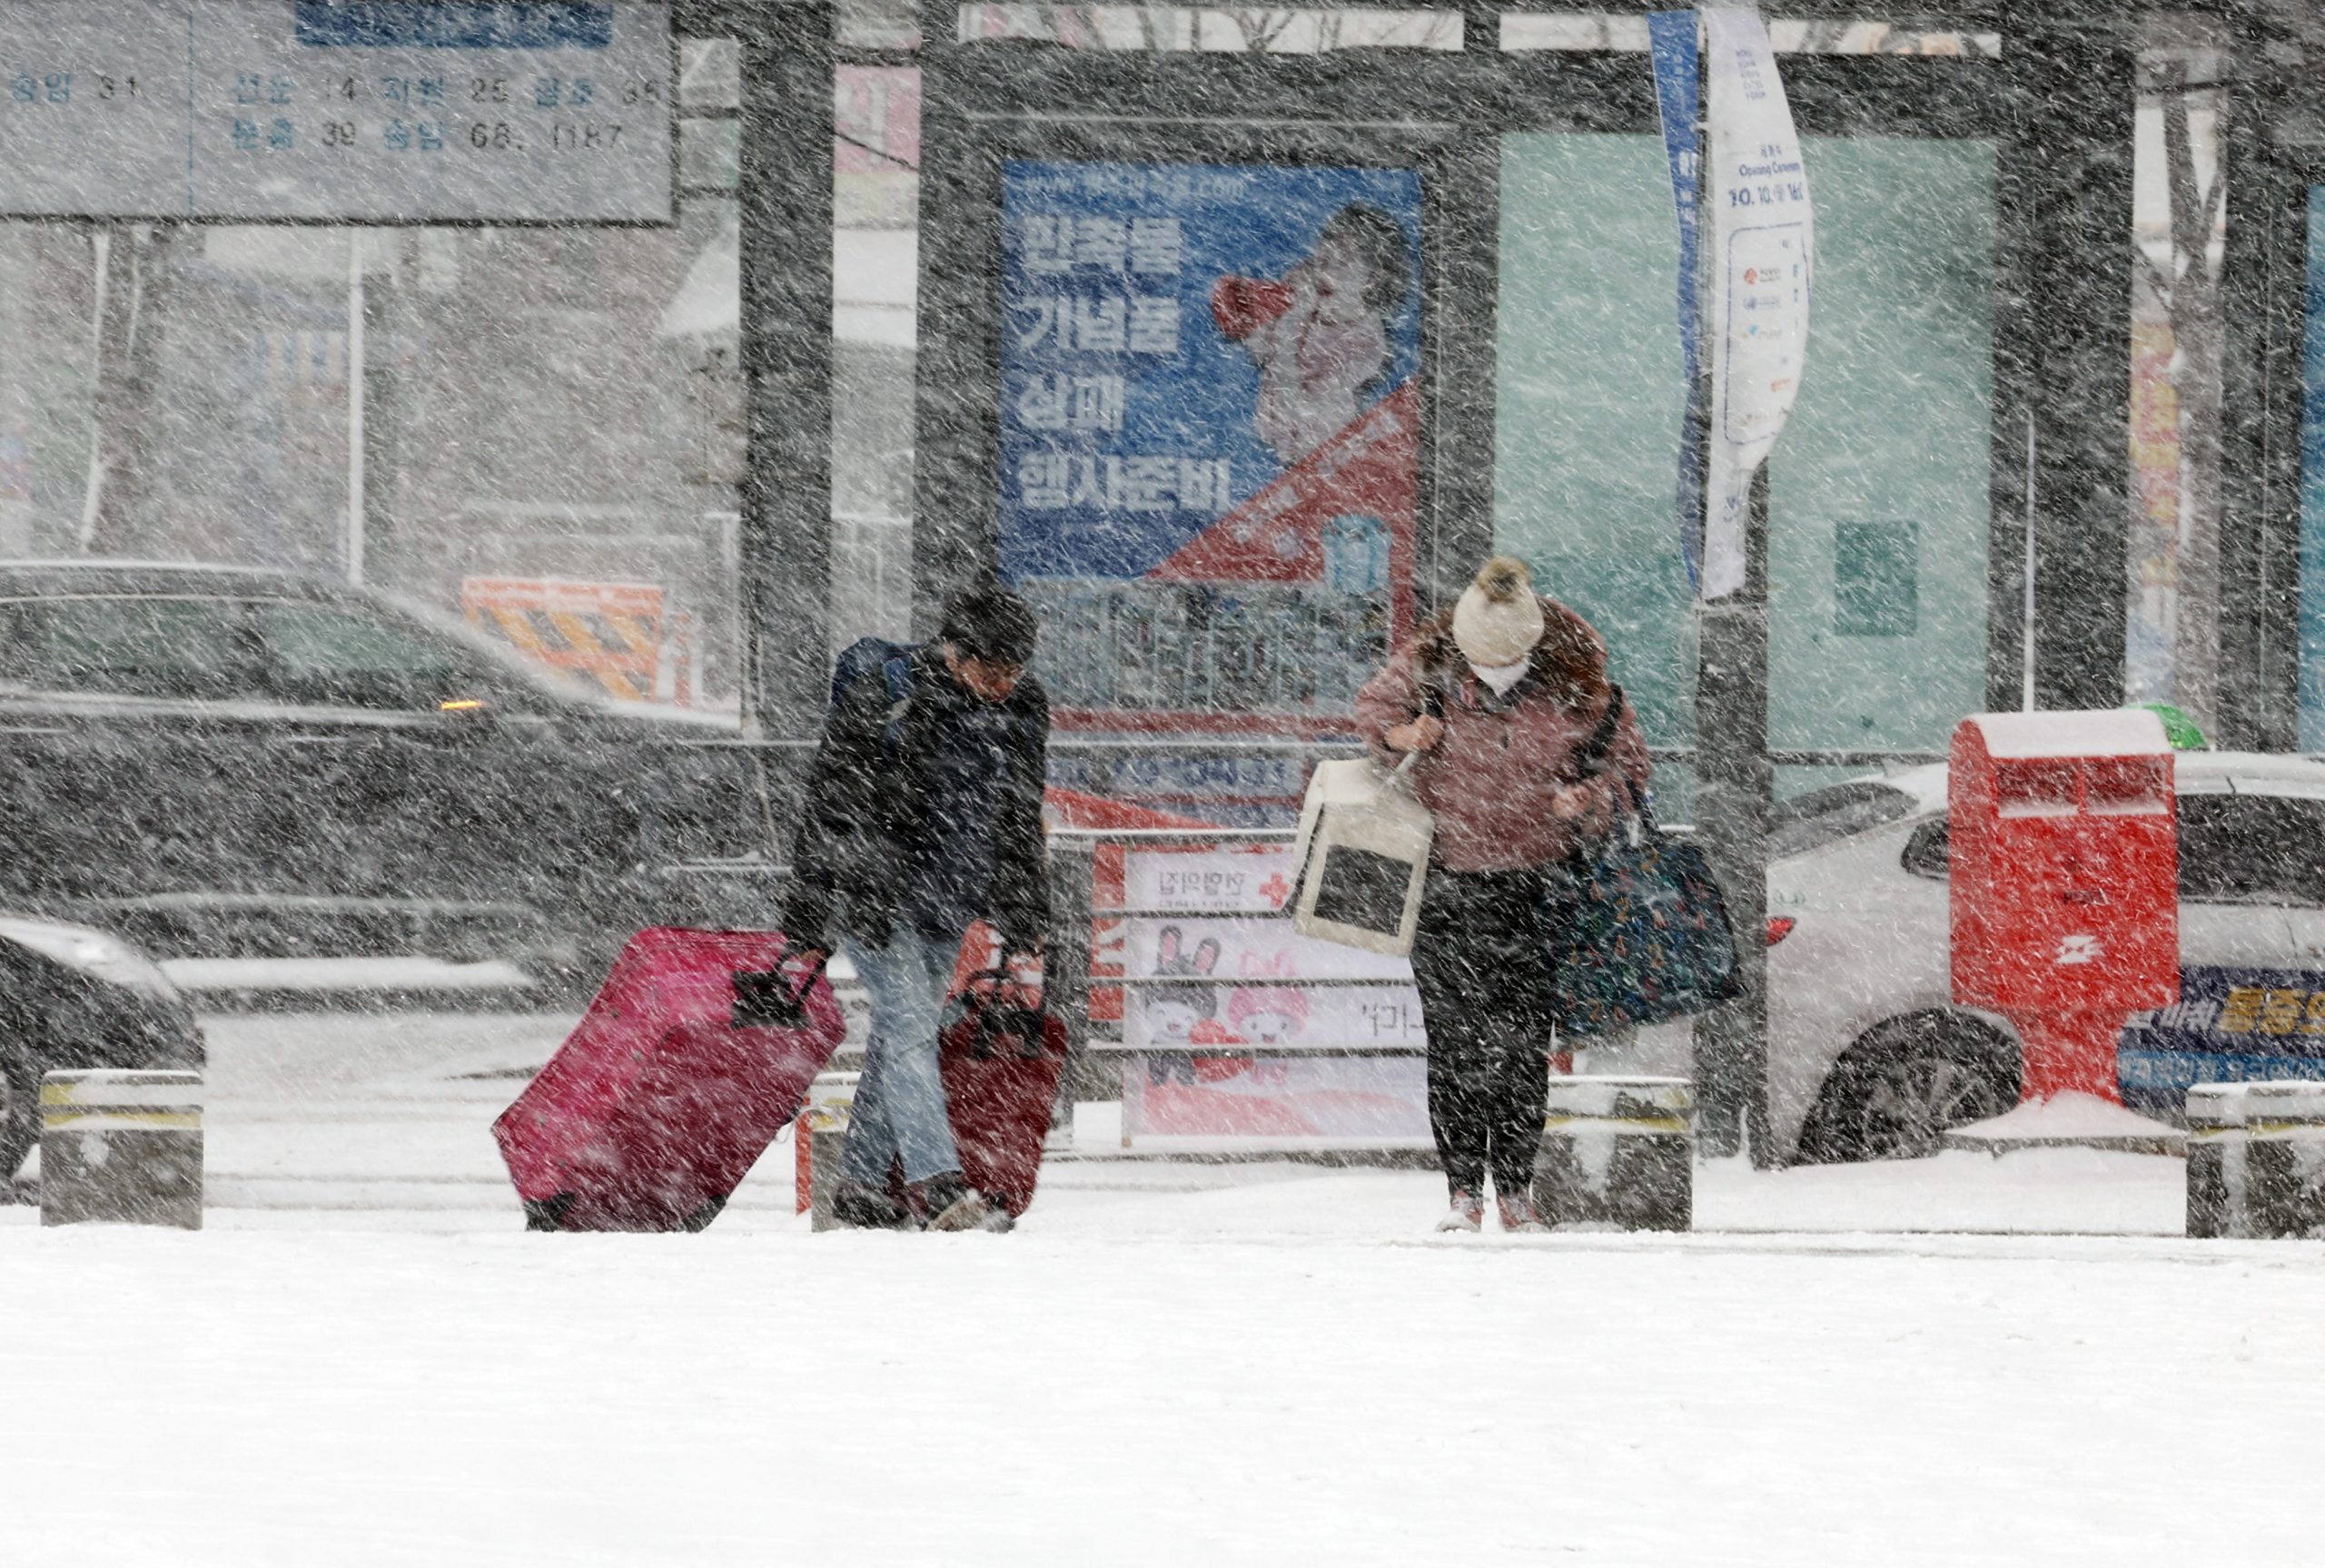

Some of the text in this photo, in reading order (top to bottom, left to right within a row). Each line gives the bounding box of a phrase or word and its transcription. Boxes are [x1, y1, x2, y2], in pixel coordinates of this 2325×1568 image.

[321, 119, 358, 148] 39
[1017, 294, 1180, 353] 기념품
[1017, 373, 1125, 432] 상패
[1017, 454, 1232, 512] 행사준비
